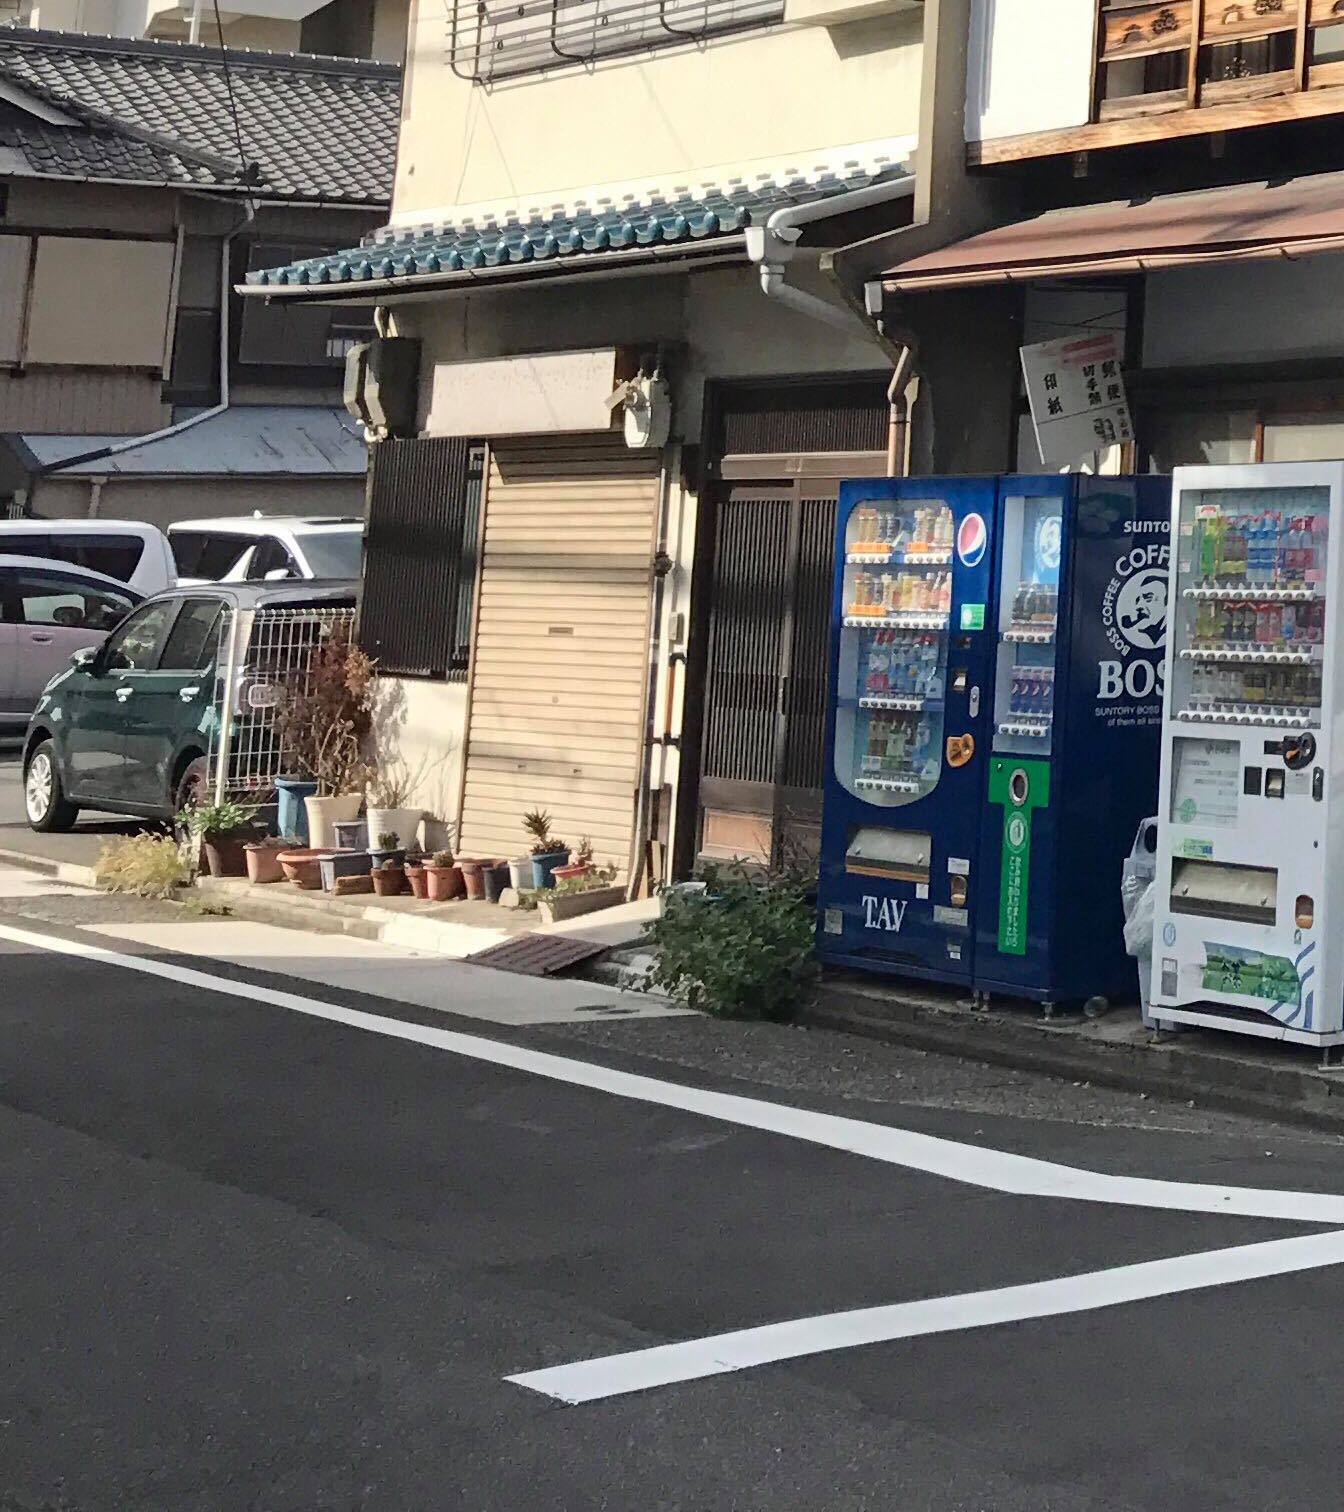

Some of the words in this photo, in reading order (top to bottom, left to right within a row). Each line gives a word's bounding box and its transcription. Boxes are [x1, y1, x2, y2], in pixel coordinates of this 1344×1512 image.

[1043, 372, 1064, 416] 印紙
[1102, 577, 1121, 626] COFFEE
[1106, 629, 1131, 657] BOSS
